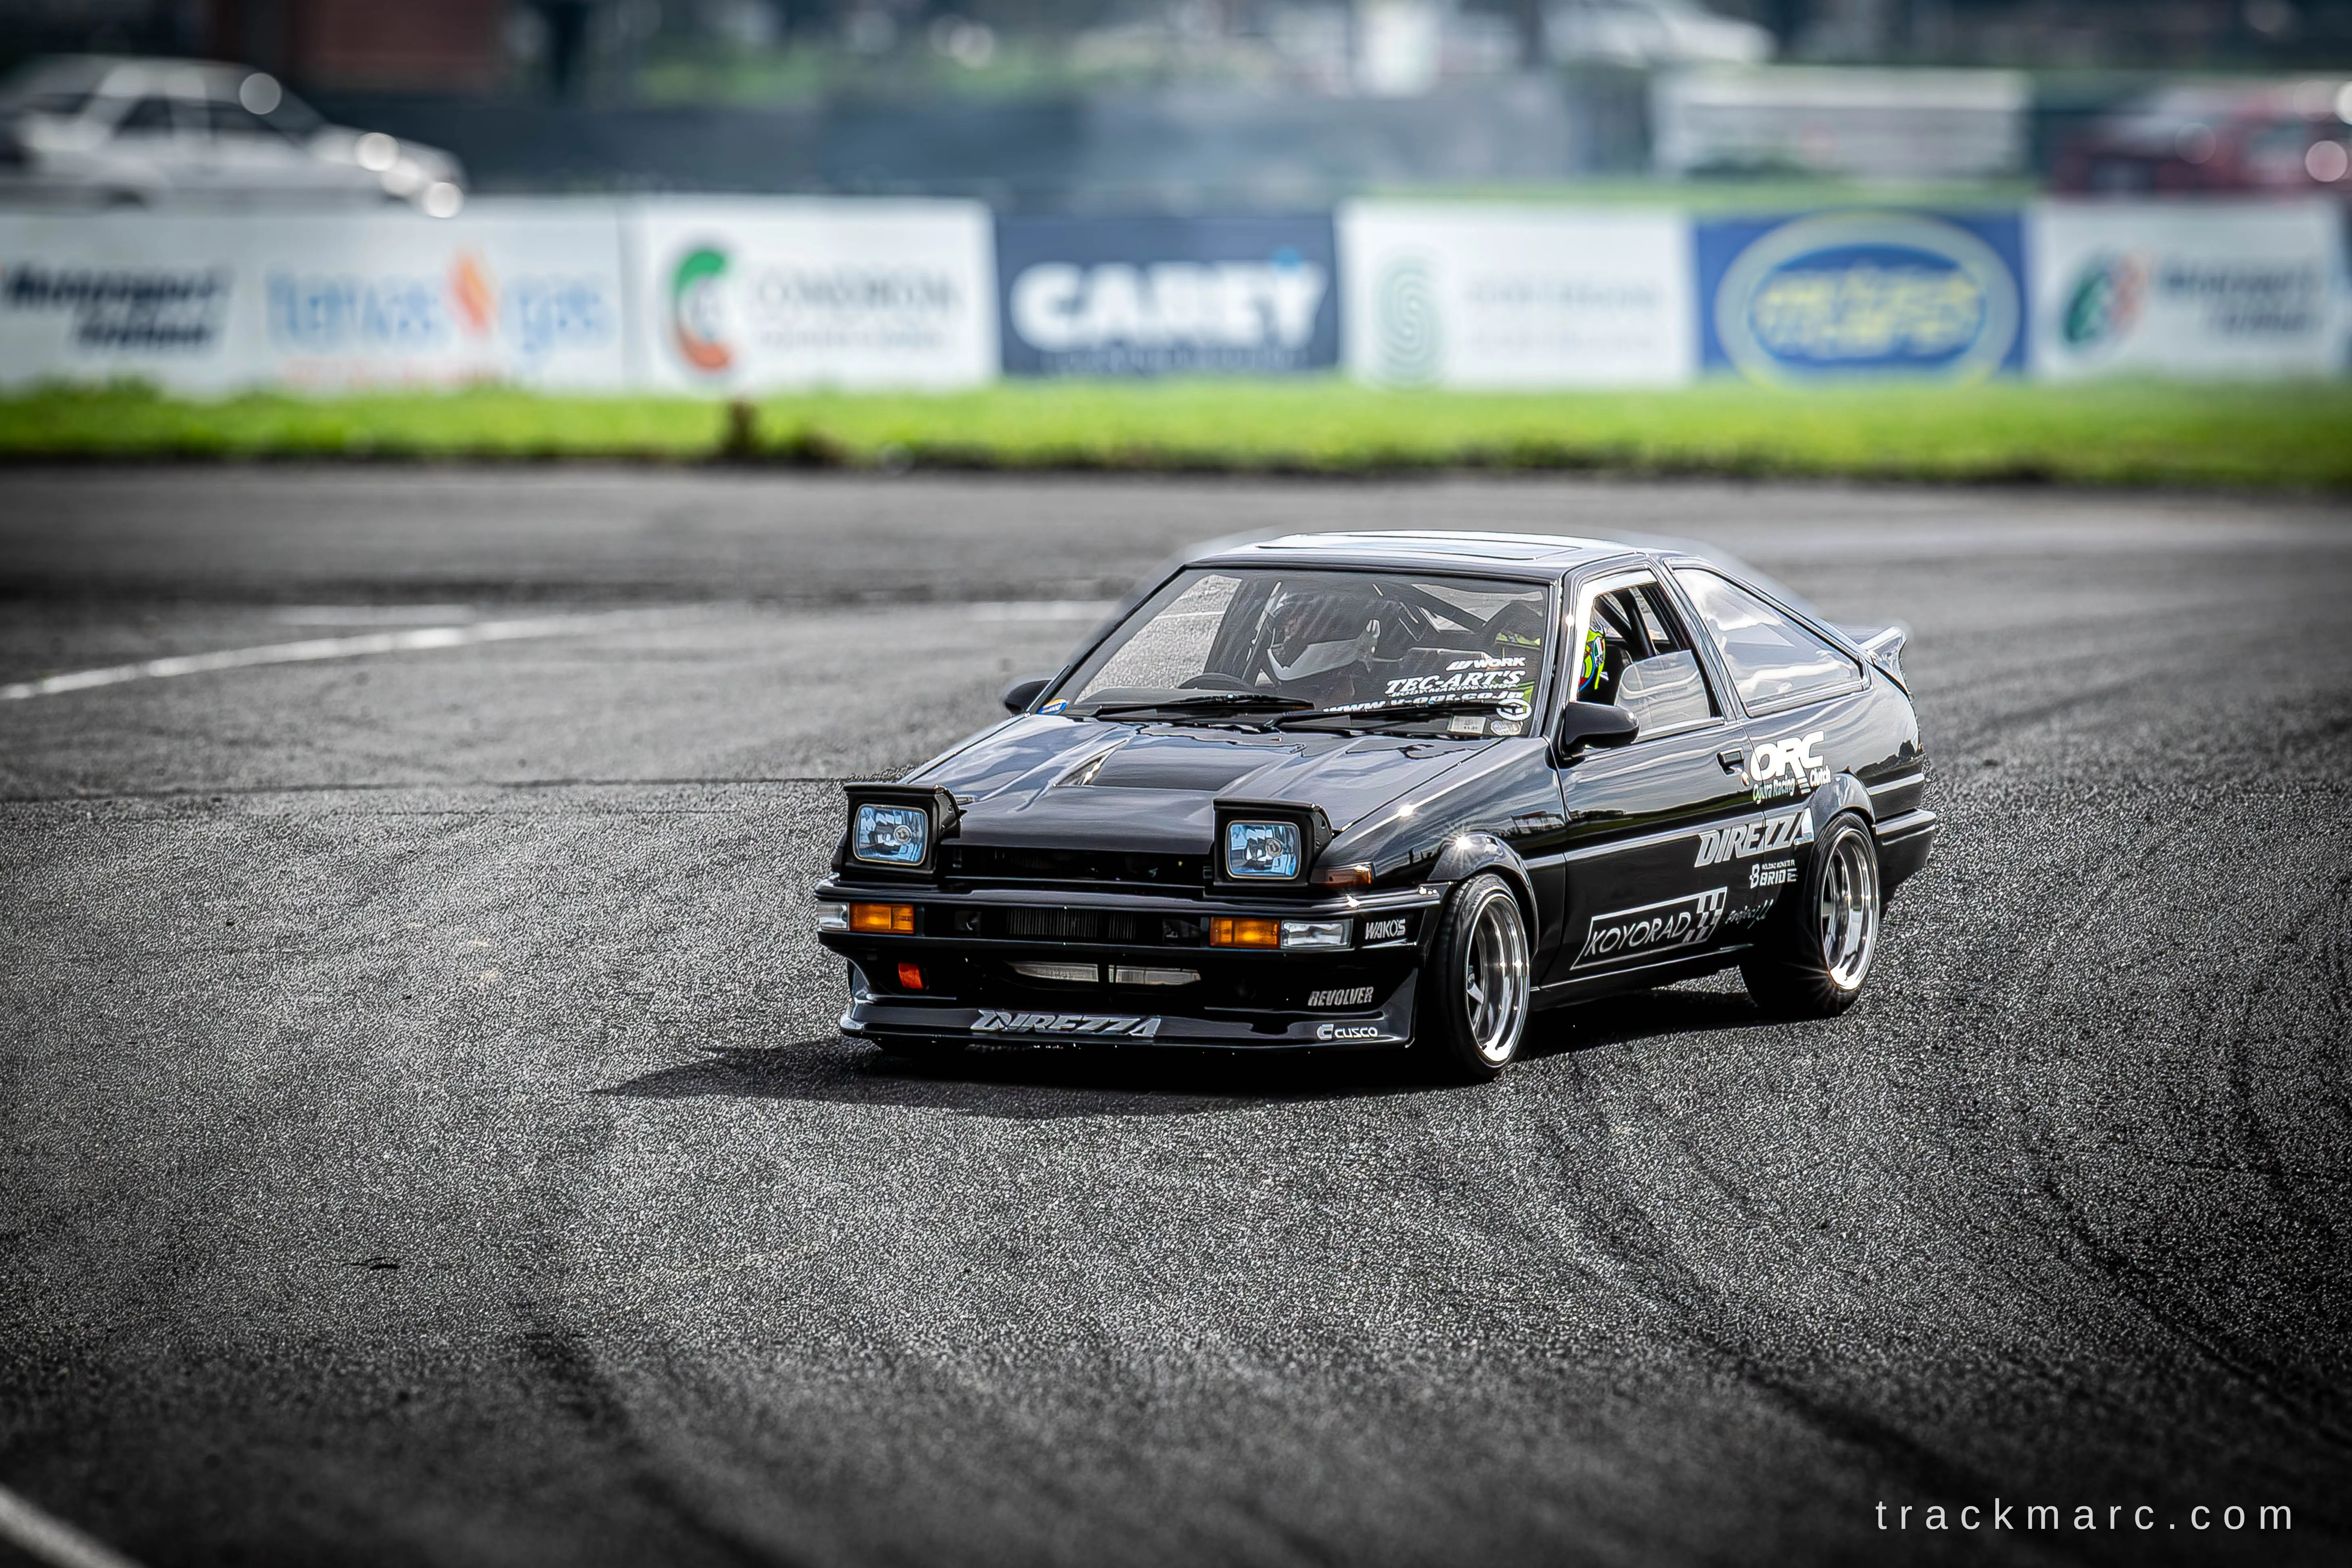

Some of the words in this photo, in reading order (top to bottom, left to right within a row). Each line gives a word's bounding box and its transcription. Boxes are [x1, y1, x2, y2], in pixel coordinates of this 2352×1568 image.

[1473, 657, 1526, 669] WORK
[1385, 670, 1526, 694] TEC-ART'S
[1750, 730, 1824, 782] ORC
[1773, 774, 1795, 797] Racing
[1810, 765, 1831, 787] Clutch
[1694, 807, 1814, 868] DIREZZA
[1365, 919, 1406, 940] WAKO'S
[1584, 911, 1691, 957] KOYORAD
[1307, 986, 1374, 1006] REVOLVER
[970, 1009, 1161, 1037] DIREZZA
